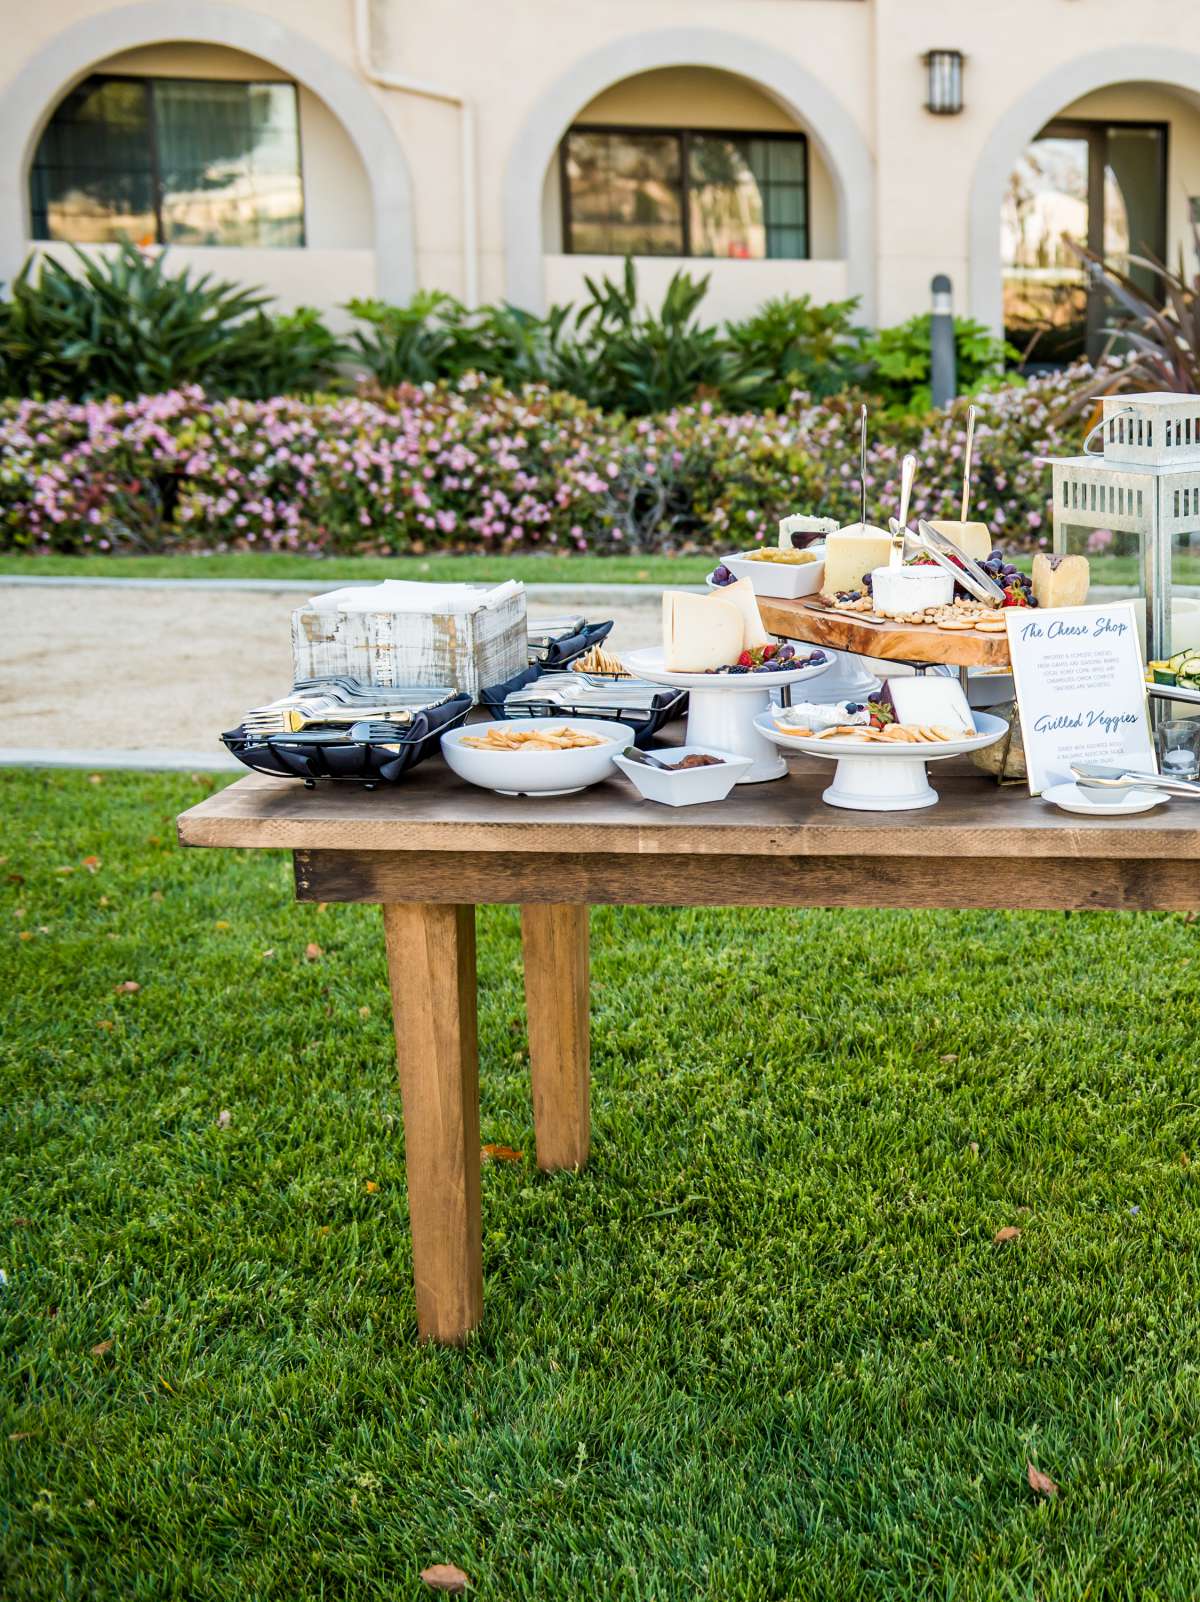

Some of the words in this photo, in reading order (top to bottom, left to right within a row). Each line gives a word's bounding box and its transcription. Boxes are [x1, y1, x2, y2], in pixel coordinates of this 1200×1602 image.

[1020, 622, 1044, 641] The
[1047, 621, 1089, 639] Cheese
[1093, 617, 1128, 637] Shop
[1034, 712, 1083, 734] Grilled
[1086, 710, 1139, 734] Veggies
